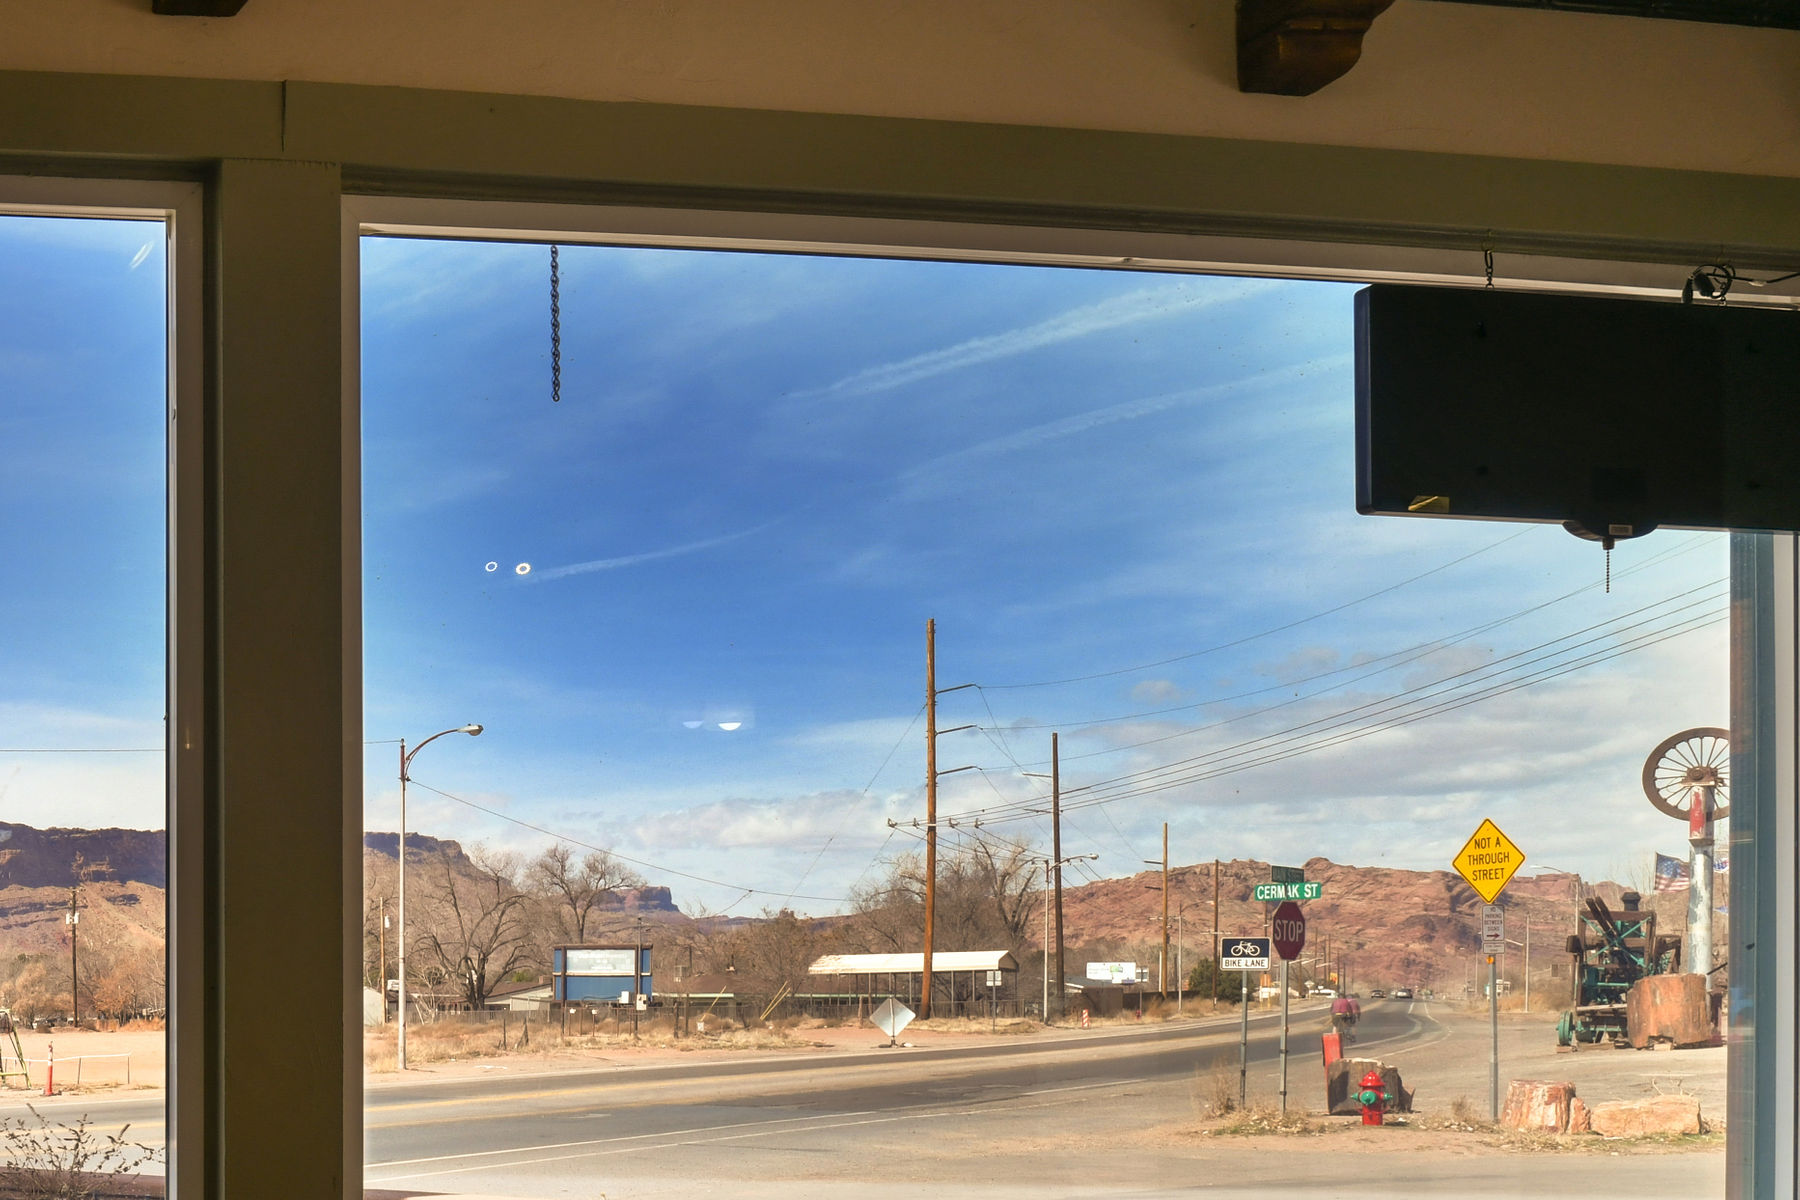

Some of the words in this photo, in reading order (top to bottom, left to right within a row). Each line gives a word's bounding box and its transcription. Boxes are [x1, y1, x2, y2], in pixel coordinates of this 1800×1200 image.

[1474, 837, 1491, 850] NOT
[1495, 836, 1501, 848] A
[1468, 851, 1510, 866] THROUGH
[1472, 868, 1505, 881] STREET
[1256, 884, 1300, 900] CERMAK
[1304, 884, 1319, 898] ST
[1274, 920, 1304, 942] STOP
[1224, 959, 1242, 968] BIKE
[1245, 959, 1266, 967] LANE
